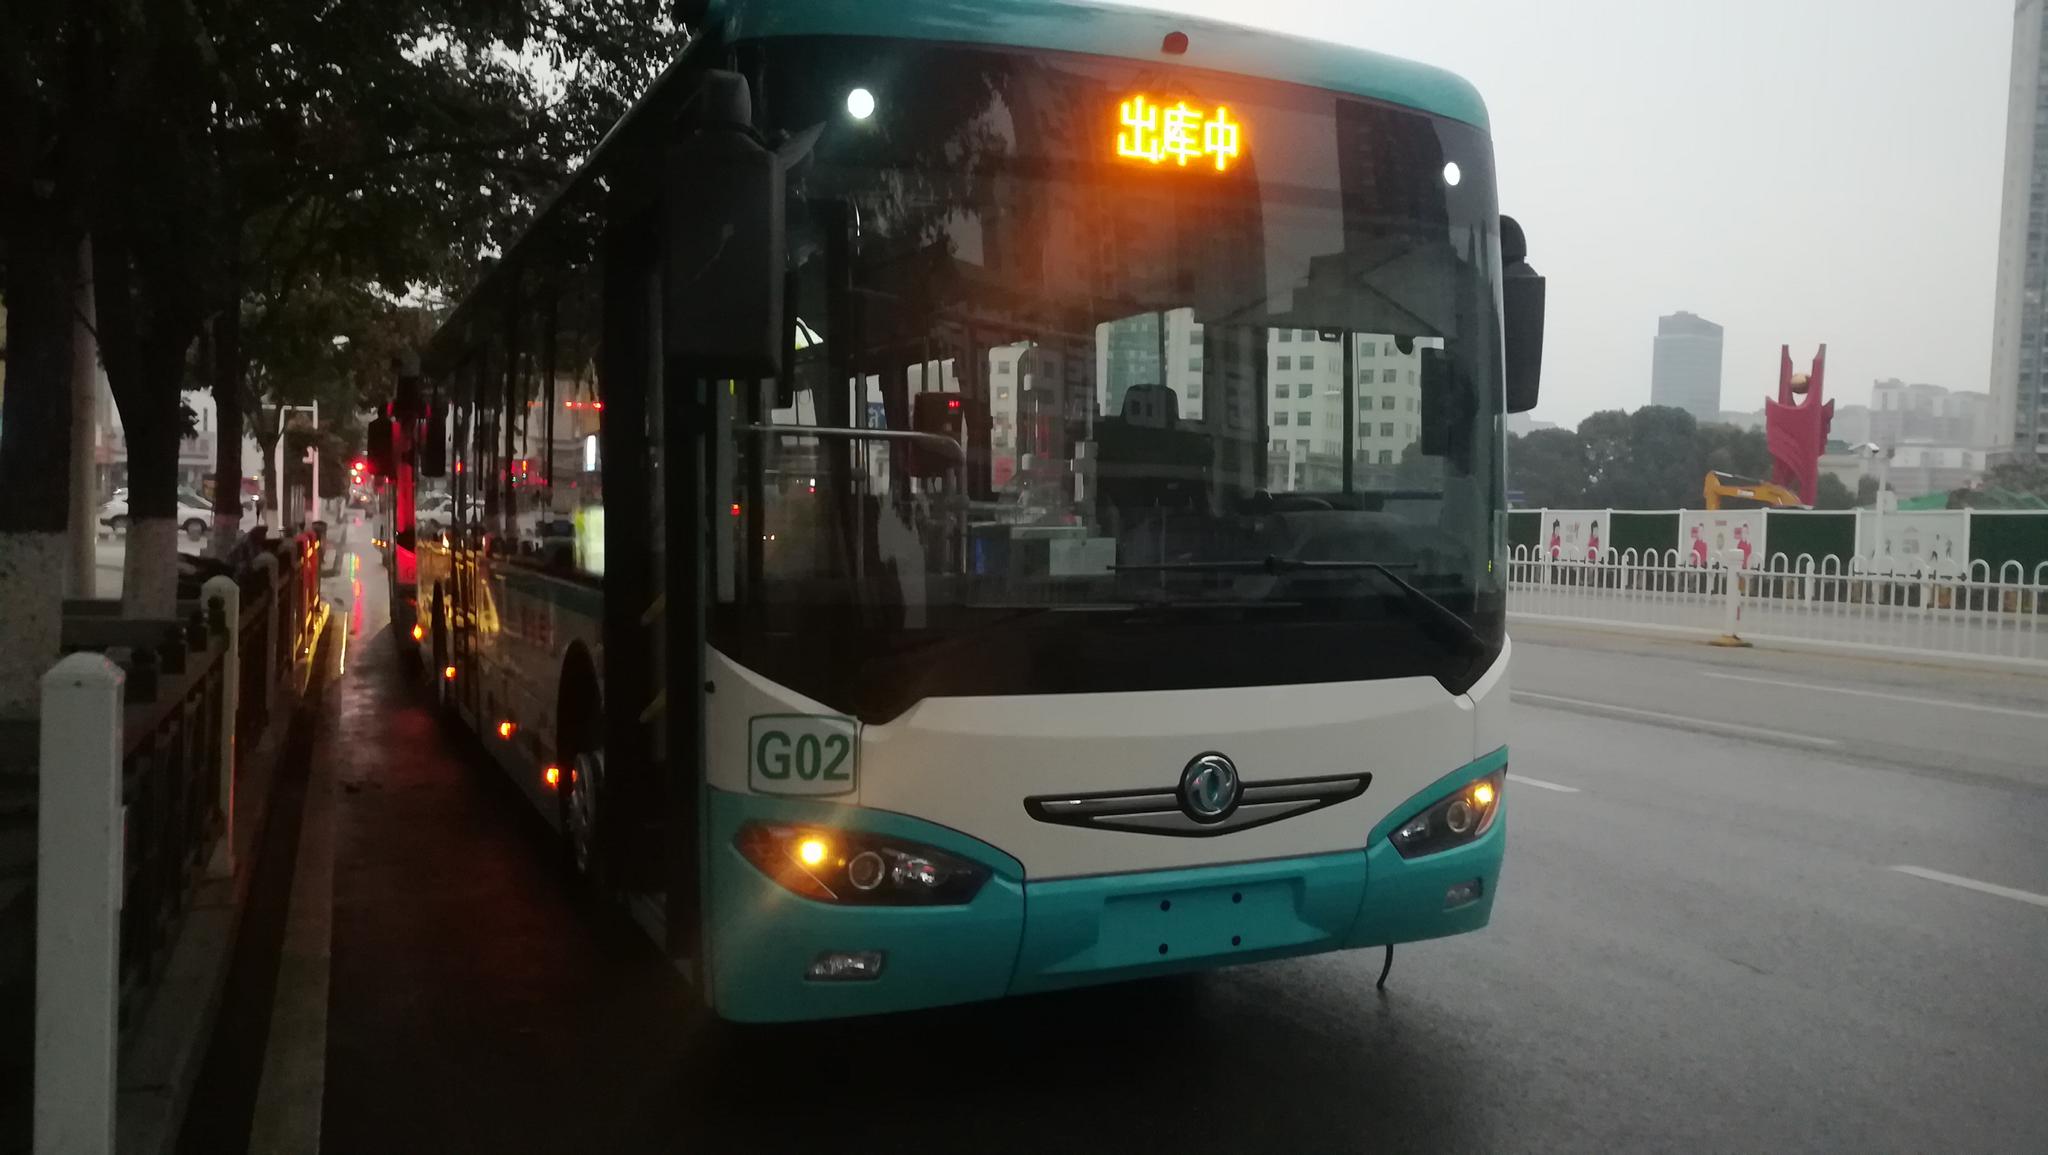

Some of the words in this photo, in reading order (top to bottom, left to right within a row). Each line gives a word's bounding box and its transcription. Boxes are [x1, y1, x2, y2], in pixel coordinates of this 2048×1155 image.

[1117, 95, 1241, 172] 出库中
[756, 730, 850, 781] G02
